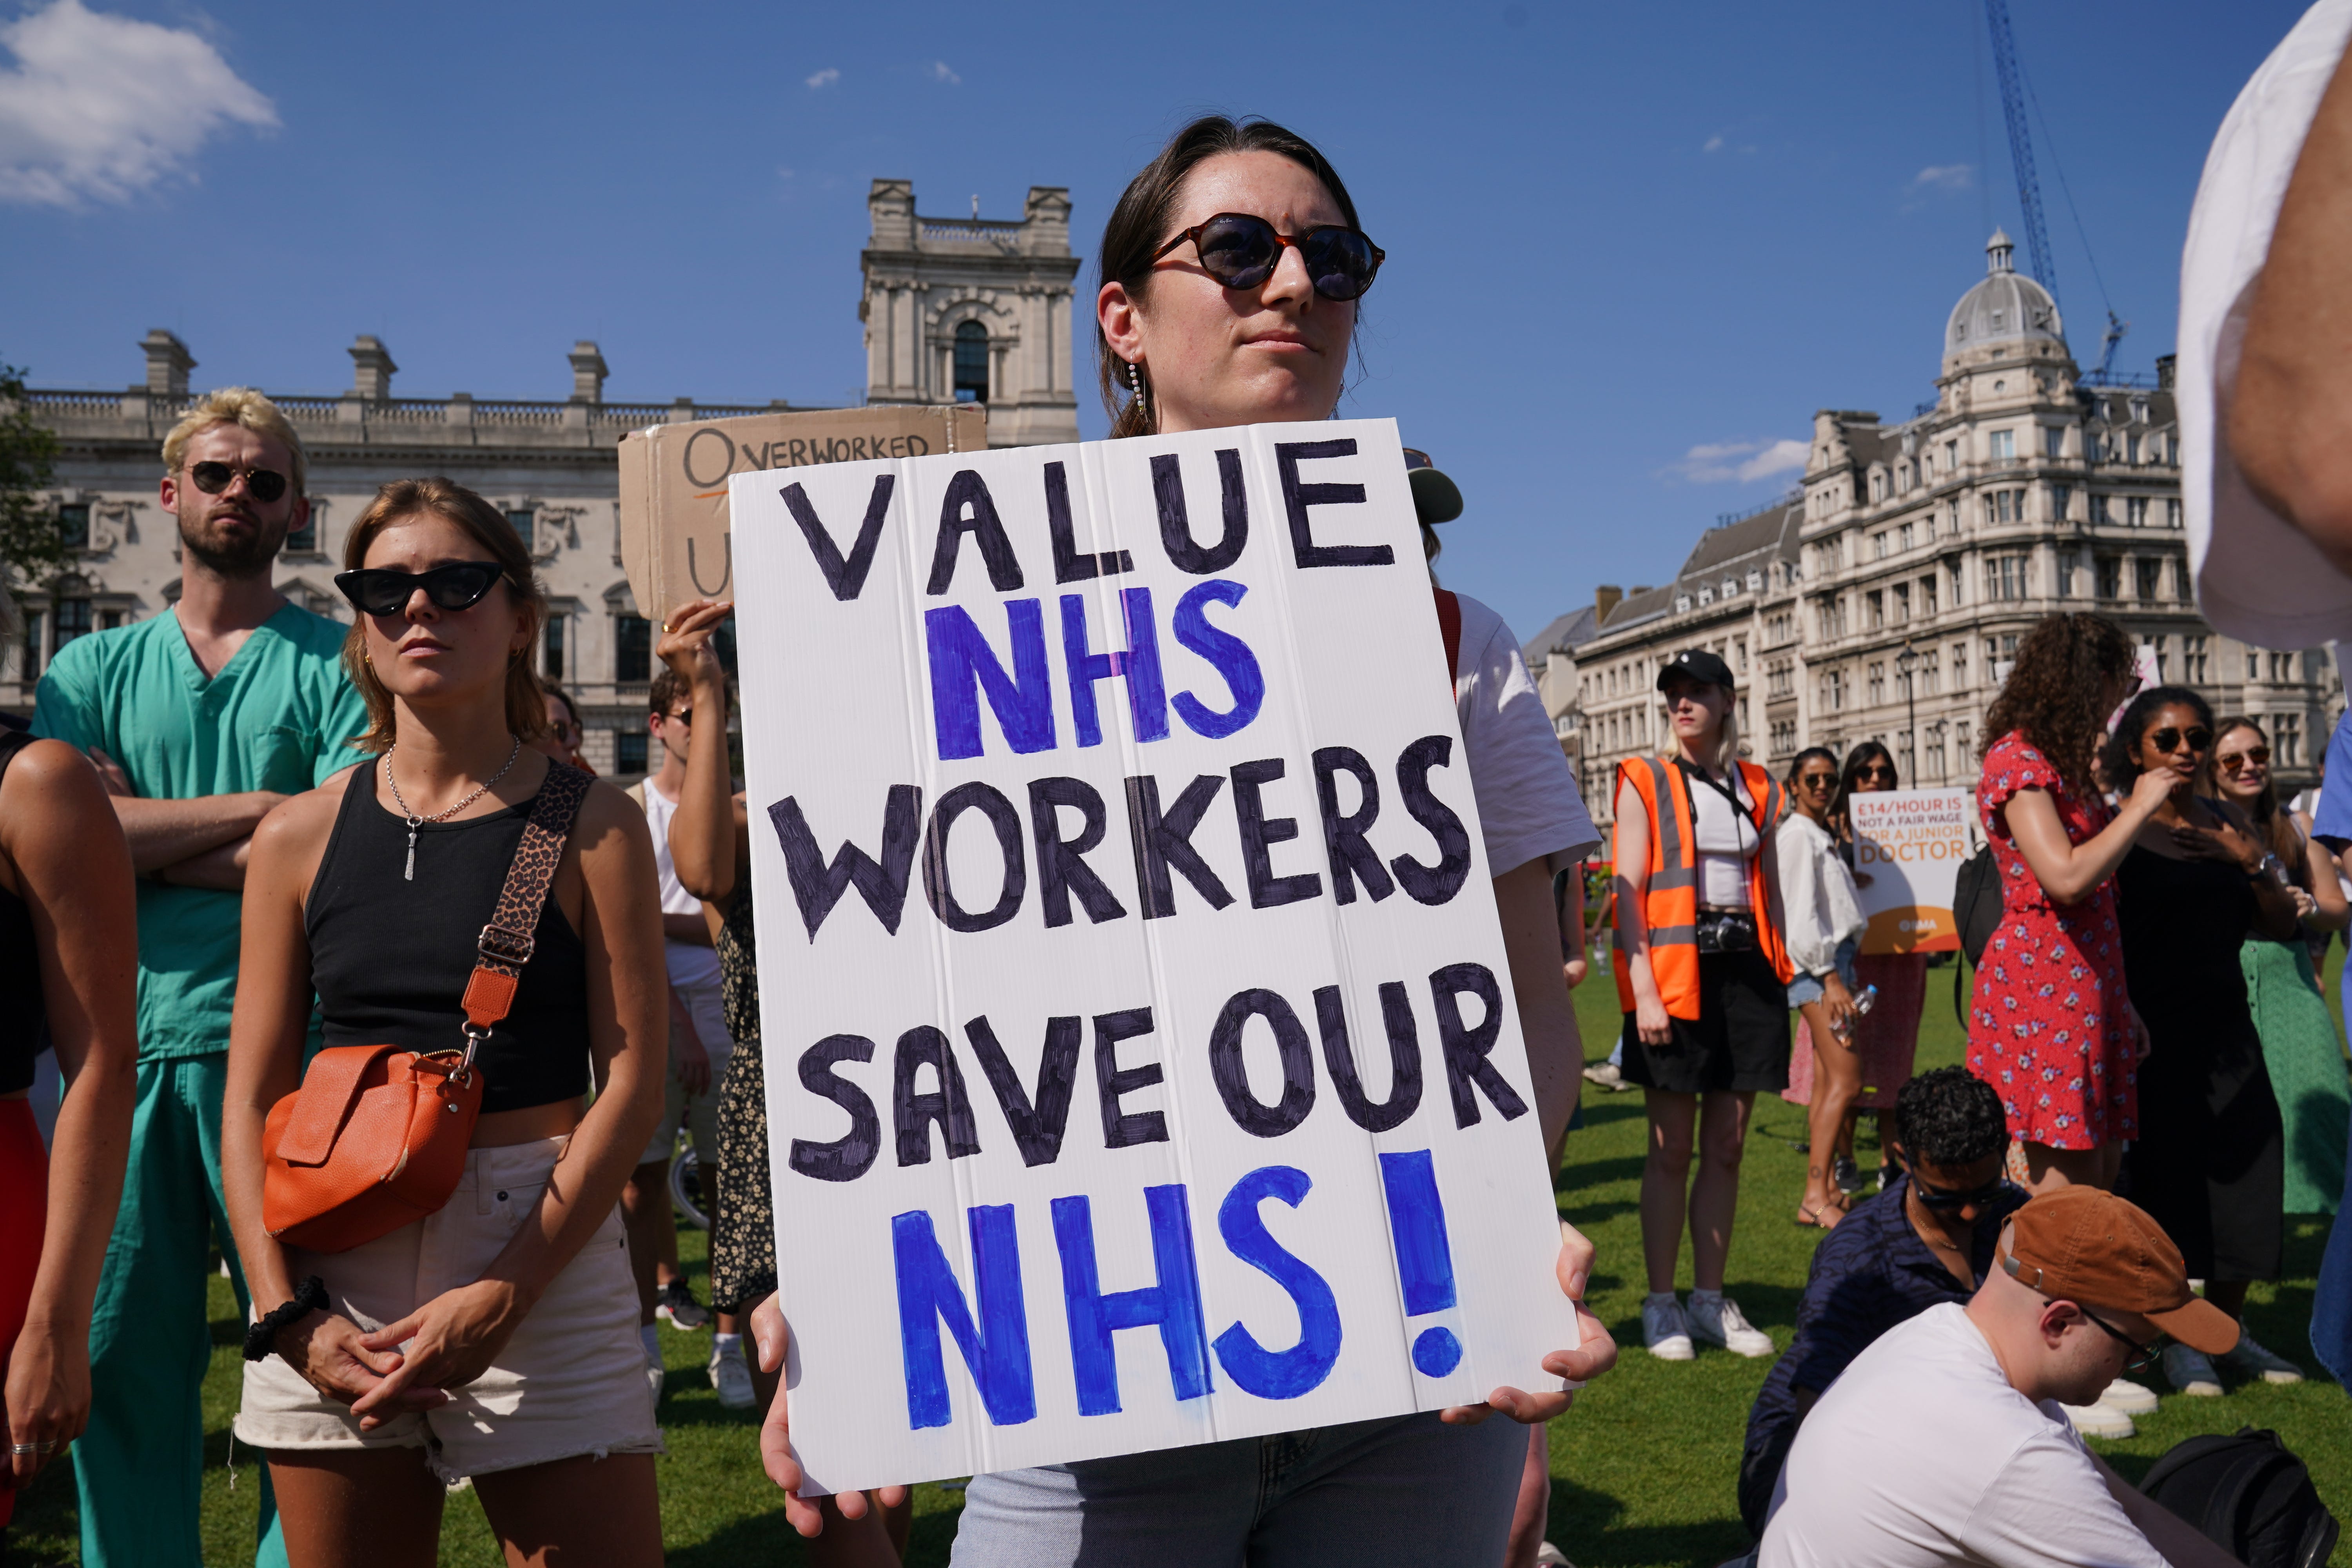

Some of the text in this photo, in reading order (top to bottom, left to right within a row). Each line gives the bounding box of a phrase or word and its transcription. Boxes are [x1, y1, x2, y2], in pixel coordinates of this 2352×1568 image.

[779, 438, 1396, 602] VALUE
[924, 579, 1265, 761] NHS
[766, 735, 1472, 946] WORKERS
[1858, 797, 1962, 816] £14/HOUR IS
[1858, 812, 1962, 828] NOT A FAIR WAGE
[1860, 825, 1964, 842] FOR A JUNIOR
[1860, 840, 1965, 865] DOCTOR
[788, 962, 1529, 1183] SAVE OUR
[891, 1148, 1461, 1431] NHS!
